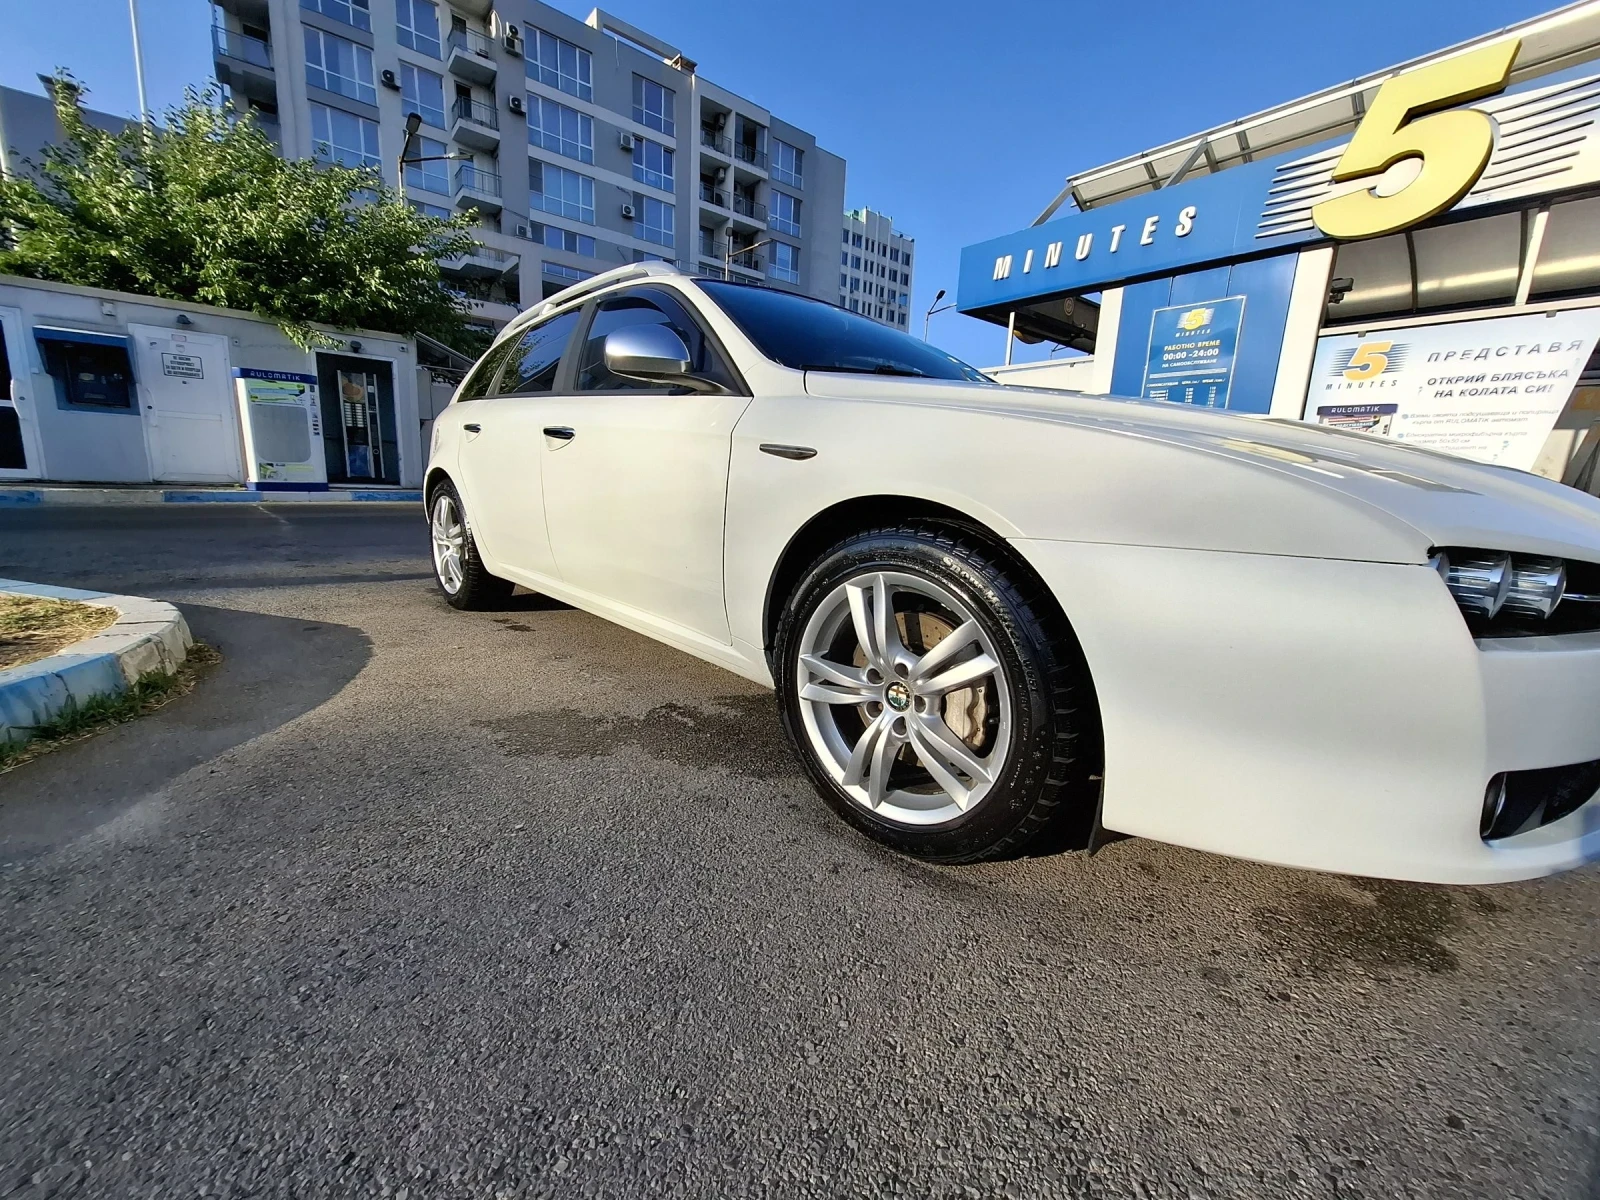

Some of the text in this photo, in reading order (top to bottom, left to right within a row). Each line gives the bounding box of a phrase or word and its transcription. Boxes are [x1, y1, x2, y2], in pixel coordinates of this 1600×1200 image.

[1311, 37, 1522, 240] 5
[993, 206, 1197, 281] MINUTES
[1184, 308, 1206, 330] 5
[1164, 340, 1220, 351] РАБОТНО ВРЕМЕ
[1427, 340, 1584, 363] ПРЕДСТАВЯ
[1163, 352, 1186, 360] 00:00
[1342, 340, 1394, 380] 5
[250, 370, 301, 381] RULOMATIK
[1427, 369, 1569, 386] ОТКРИЙ БЛЯСЪКА
[1325, 379, 1398, 390] MINUTES
[1434, 383, 1555, 398] НА КОЛАТА СИ!
